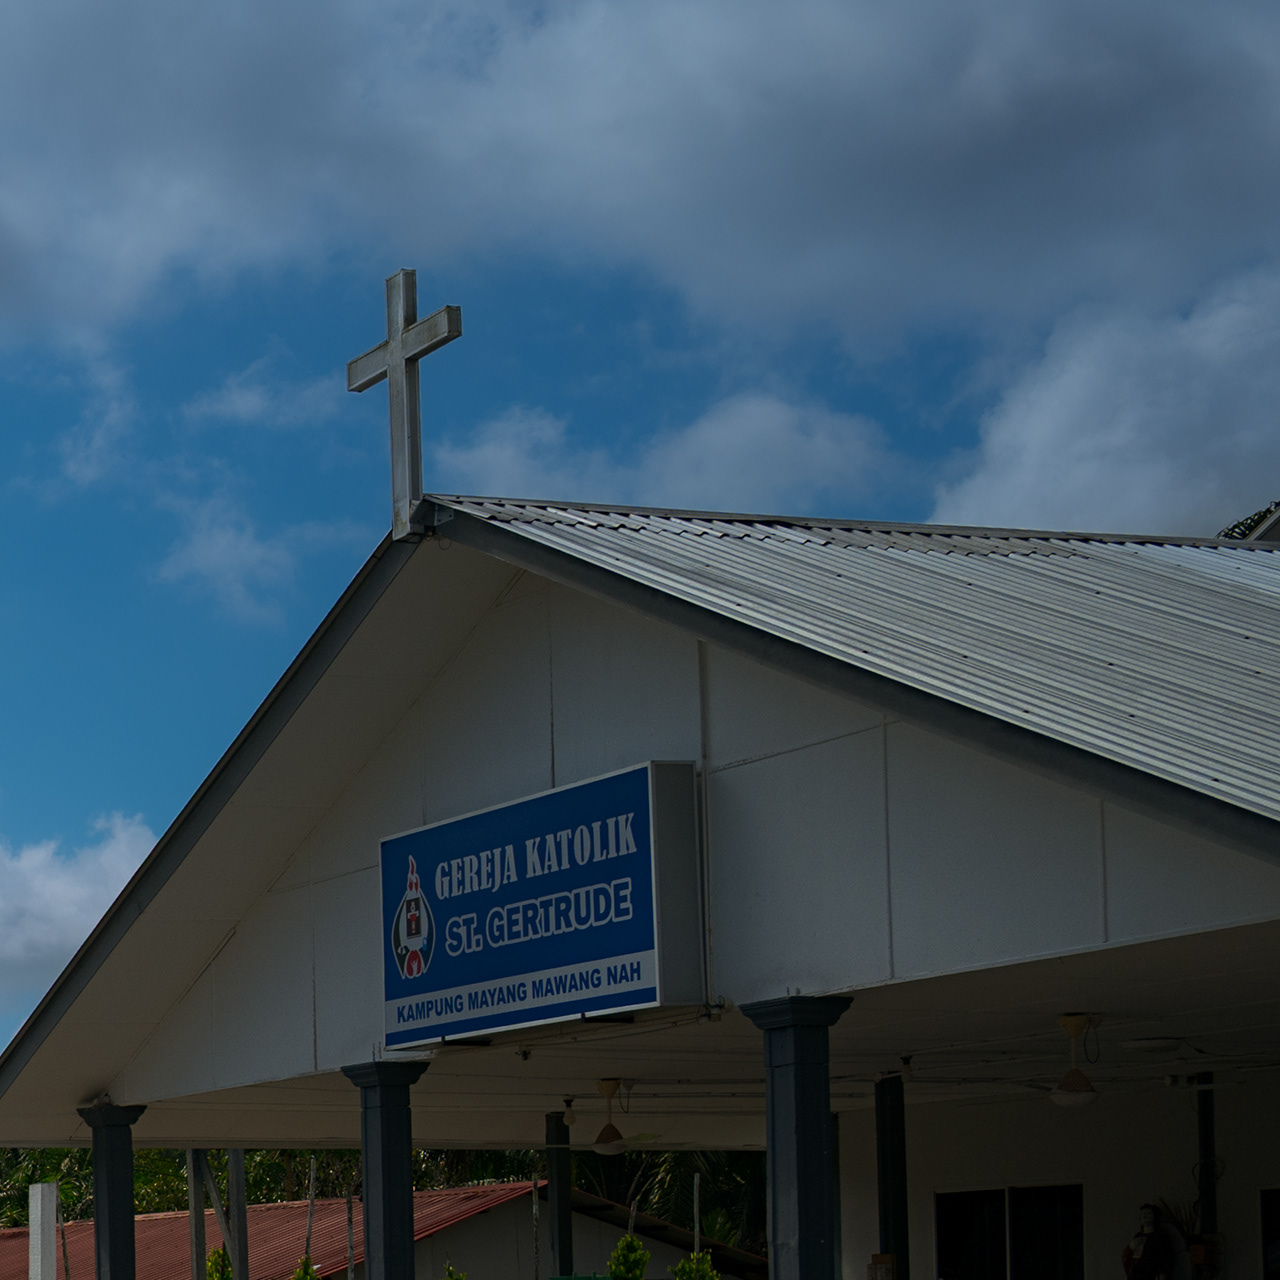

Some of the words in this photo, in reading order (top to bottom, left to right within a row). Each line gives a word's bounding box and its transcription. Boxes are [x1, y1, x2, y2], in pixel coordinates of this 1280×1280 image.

[435, 844, 518, 900] GEREJA
[525, 812, 637, 879] KATOLIK
[445, 913, 483, 956] ST.
[486, 877, 633, 948] GERTRUDE
[397, 994, 464, 1023] KAMPUNG
[468, 982, 527, 1010] MAYANG
[532, 968, 602, 998] MAWANG
[607, 961, 641, 986] NAH
